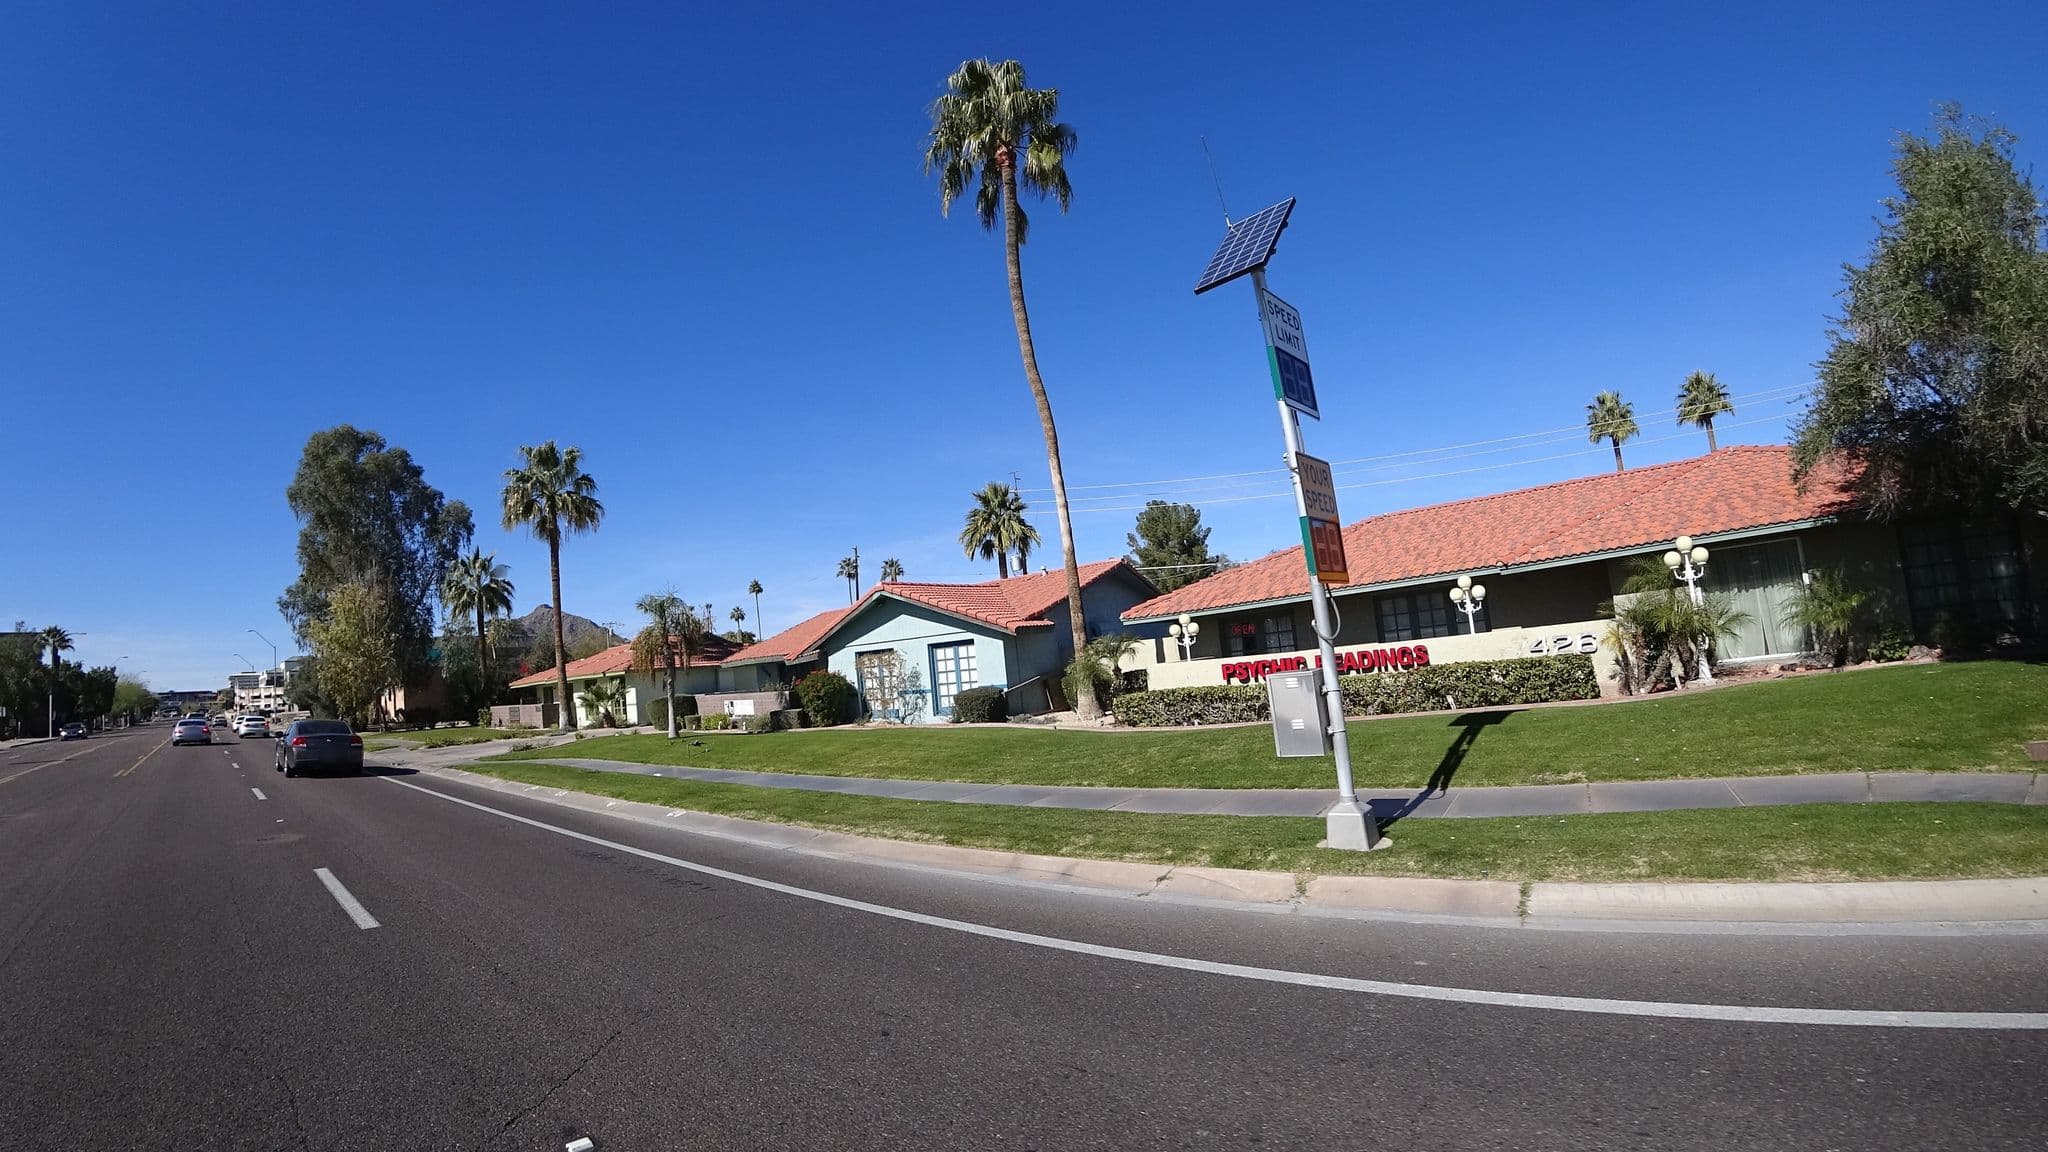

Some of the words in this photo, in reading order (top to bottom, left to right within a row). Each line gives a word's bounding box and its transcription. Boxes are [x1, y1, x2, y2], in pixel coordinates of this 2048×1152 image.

[1267, 300, 1300, 331] SPEED
[1275, 324, 1301, 351] LIMIT
[1302, 462, 1330, 489] YOUR
[1305, 489, 1336, 514] SPEED
[1529, 633, 1598, 655] 426
[1221, 656, 1307, 682] PSYCHIC
[1315, 645, 1429, 672] EADINGS
